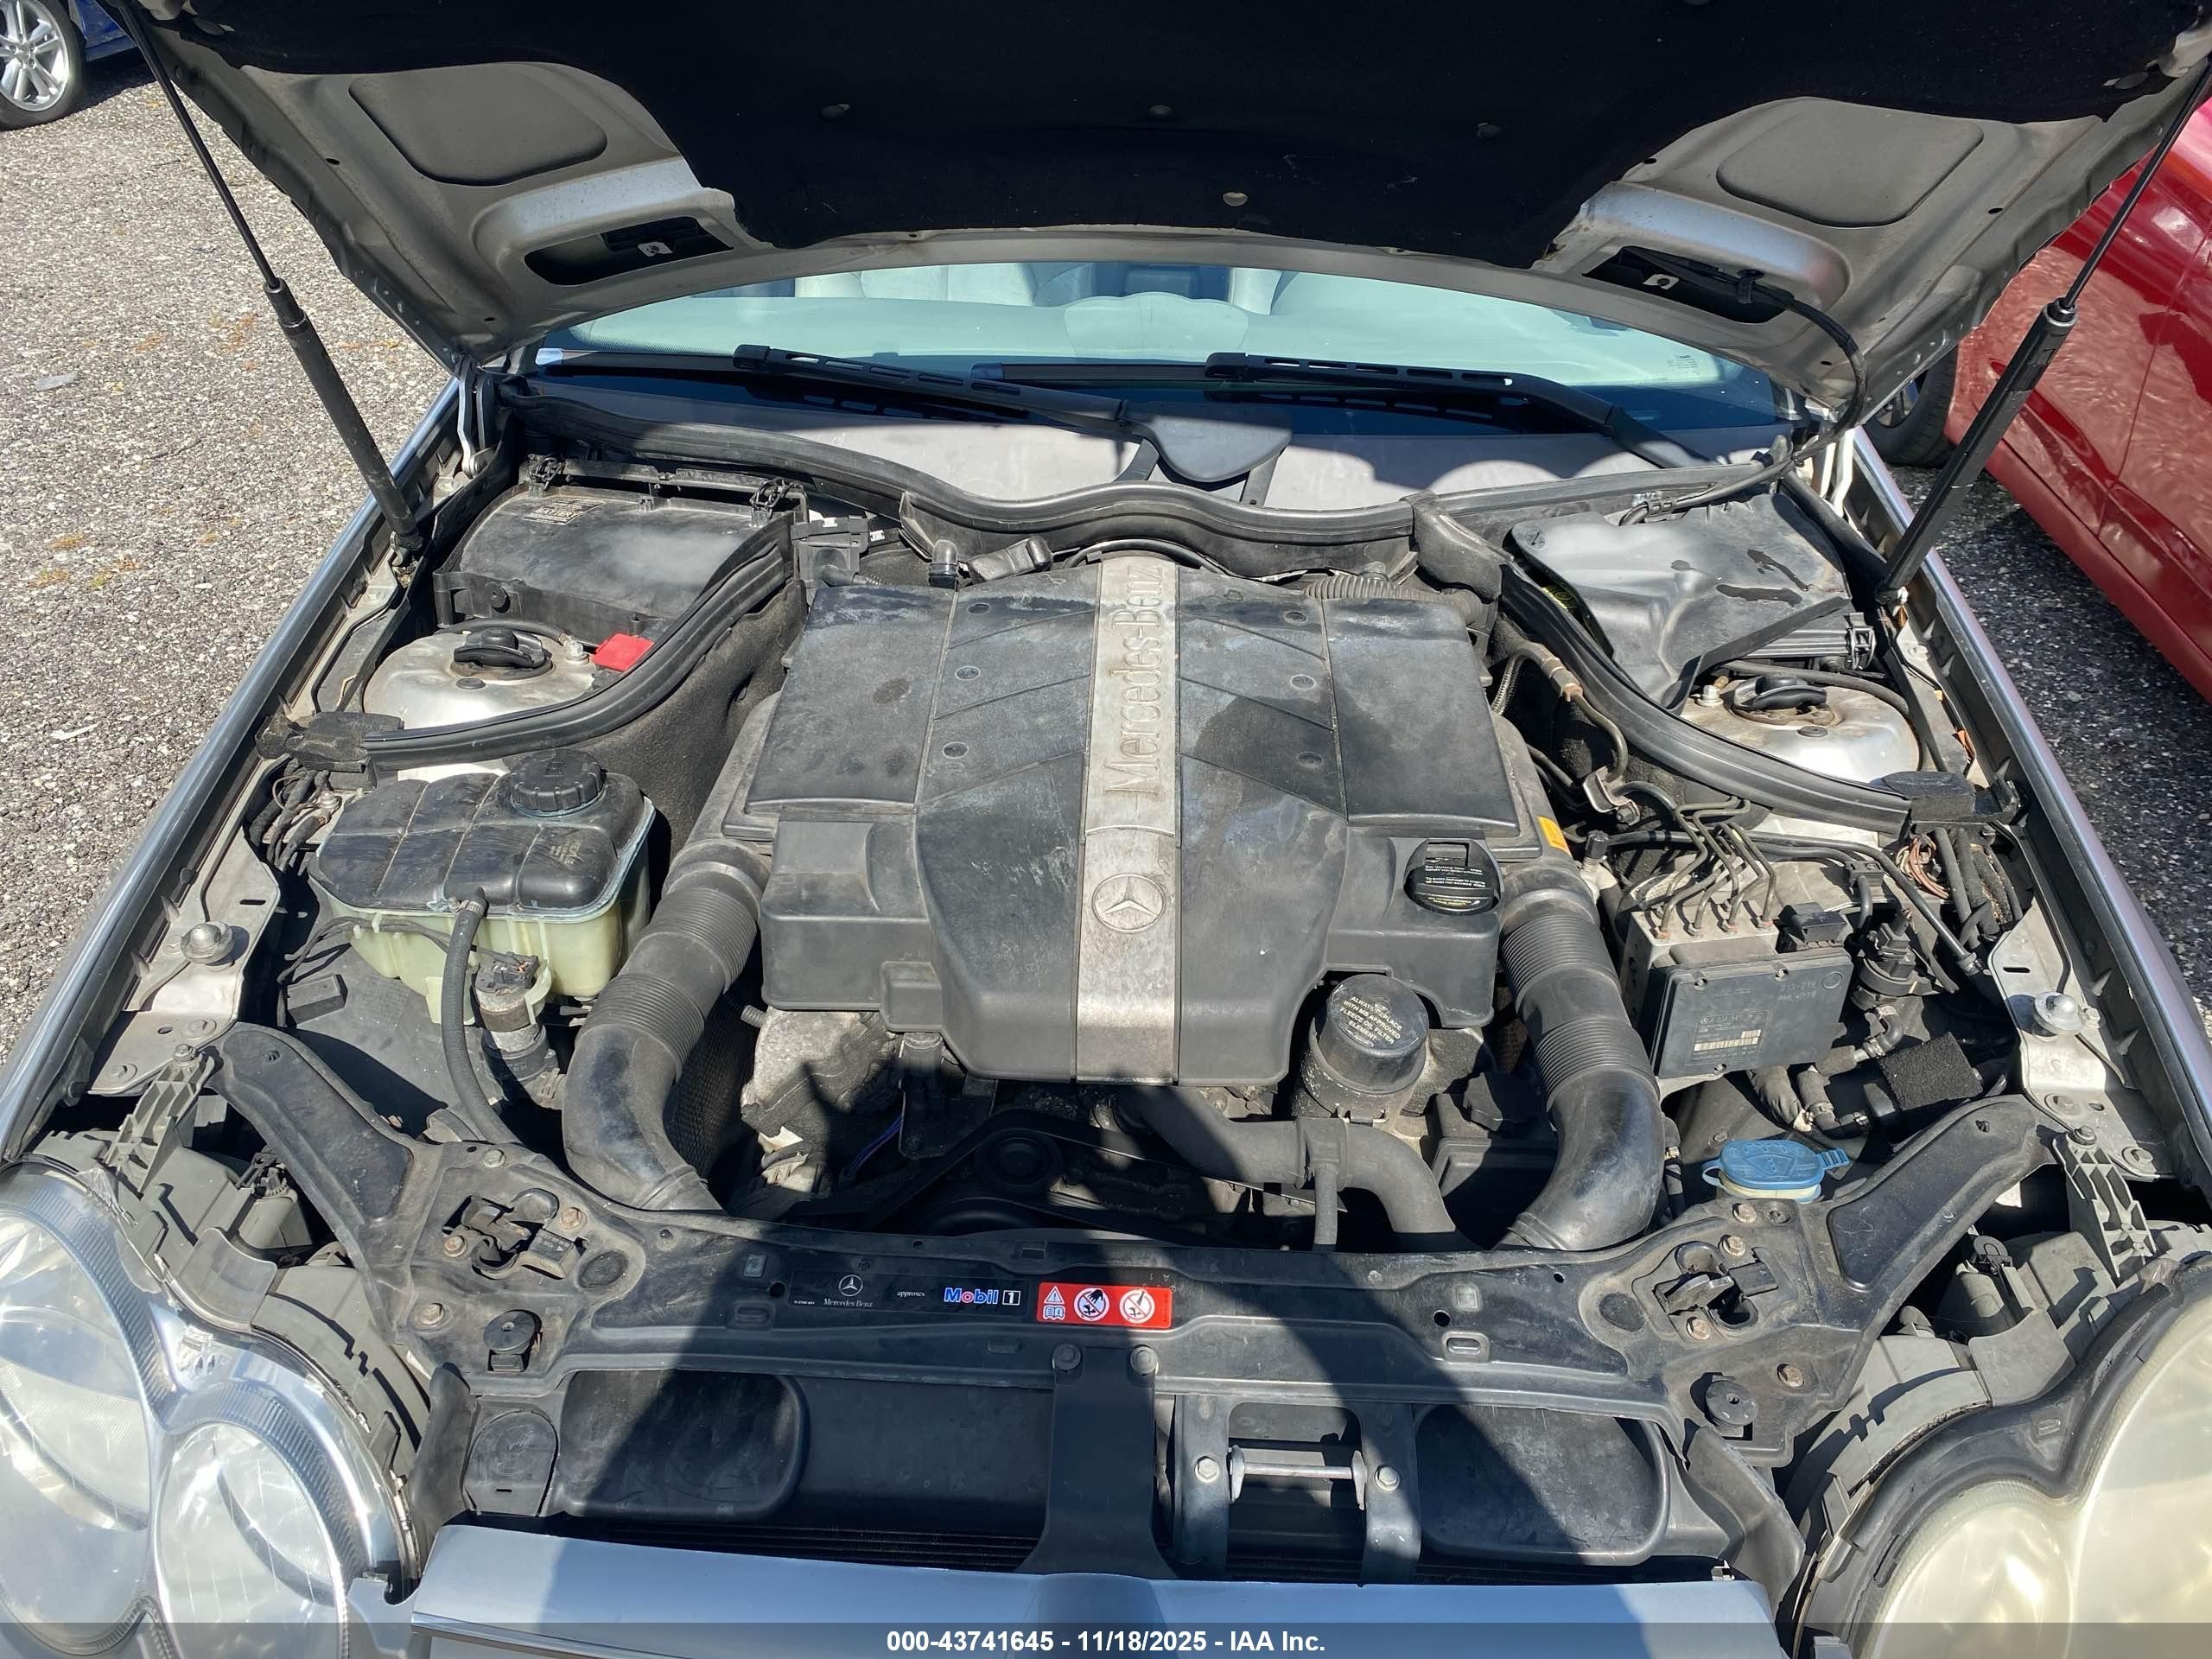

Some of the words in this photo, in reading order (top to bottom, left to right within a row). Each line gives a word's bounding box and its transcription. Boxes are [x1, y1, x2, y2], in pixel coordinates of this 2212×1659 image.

[1103, 566, 1164, 796] Mercedes-Benz
[1339, 1007, 1364, 1022] FLEECE
[1363, 1020, 1373, 1030] OIL
[1374, 1027, 1395, 1044] FILTER
[1344, 1001, 1359, 1010] WITH
[1369, 1014, 1401, 1039] APPROVED
[1348, 1020, 1377, 1039] ELEMENT
[1351, 996, 1374, 1010] ALWAYS
[1375, 1009, 1402, 1030] REPLACE
[944, 1287, 999, 1305] Mobil
